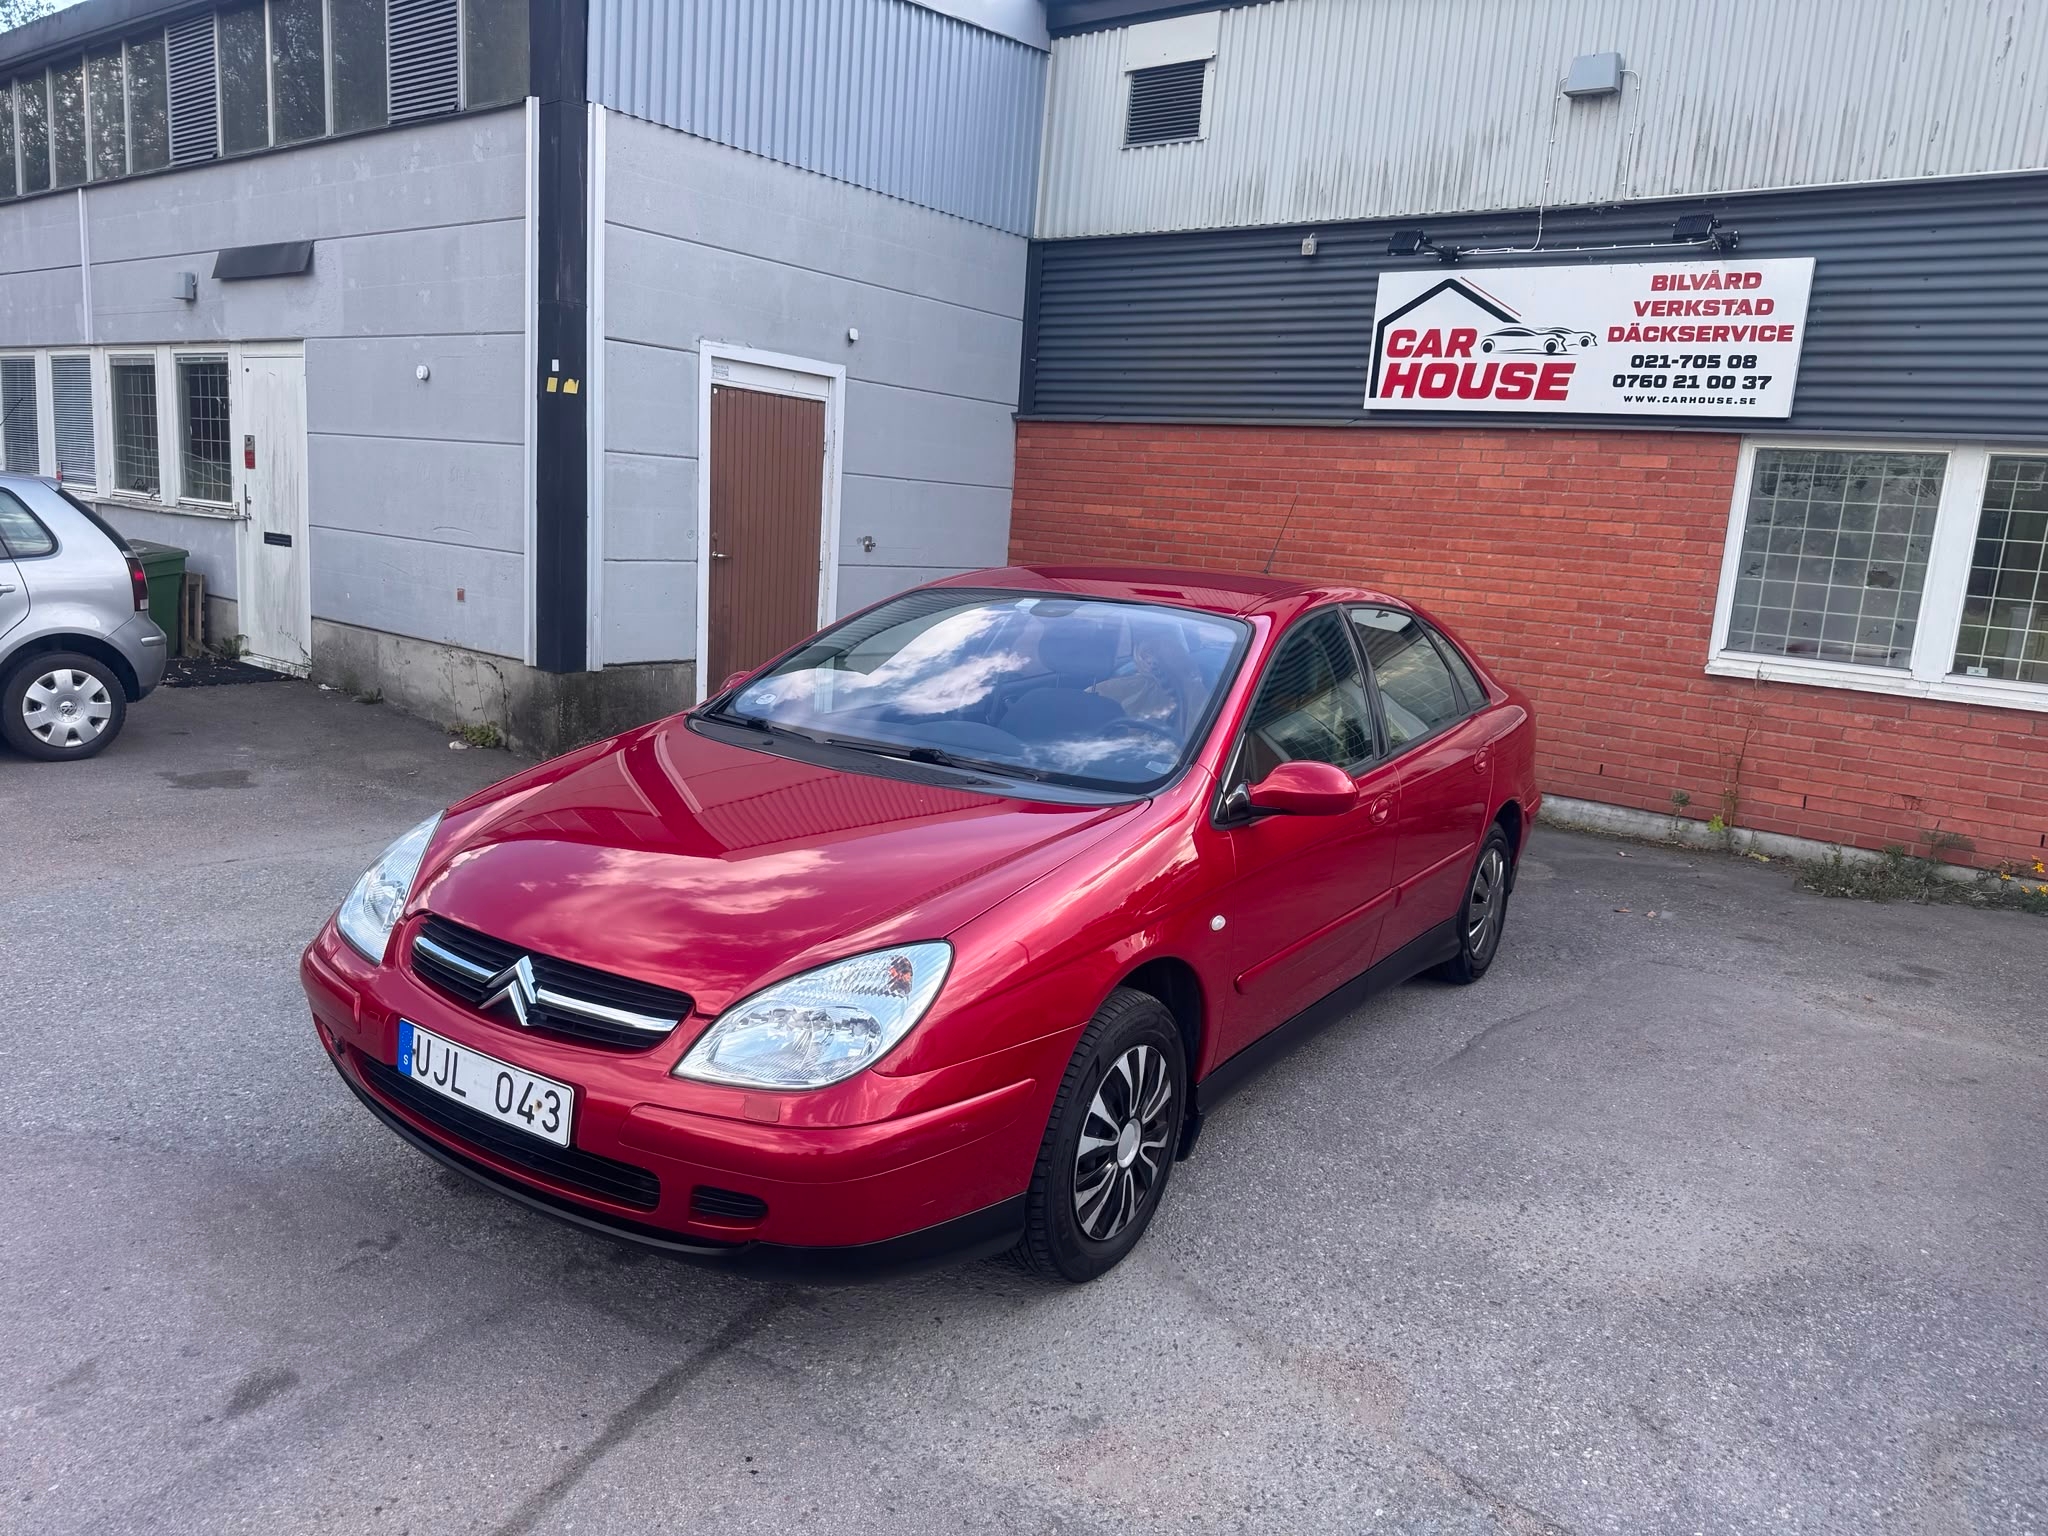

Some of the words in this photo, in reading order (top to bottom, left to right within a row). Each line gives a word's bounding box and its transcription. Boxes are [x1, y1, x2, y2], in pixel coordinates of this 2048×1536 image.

[1650, 270, 1763, 291] BILVÅRD
[1633, 299, 1775, 317] VERKSTAD
[1607, 322, 1795, 342] DÄCKSERVICE
[1386, 328, 1478, 358] CAR
[1630, 354, 1722, 369] 021-705
[1727, 354, 1758, 369] 08
[1380, 362, 1577, 401] HOUSE
[1612, 374, 1668, 388] 0760
[1672, 375, 1700, 389] 21
[1706, 375, 1737, 390] 00
[1742, 375, 1772, 390] 37
[1623, 395, 1757, 405] WWW.CARHOUSE.SE
[403, 1054, 409, 1066] S
[415, 1034, 467, 1098] UJL
[494, 1071, 562, 1134] 043
